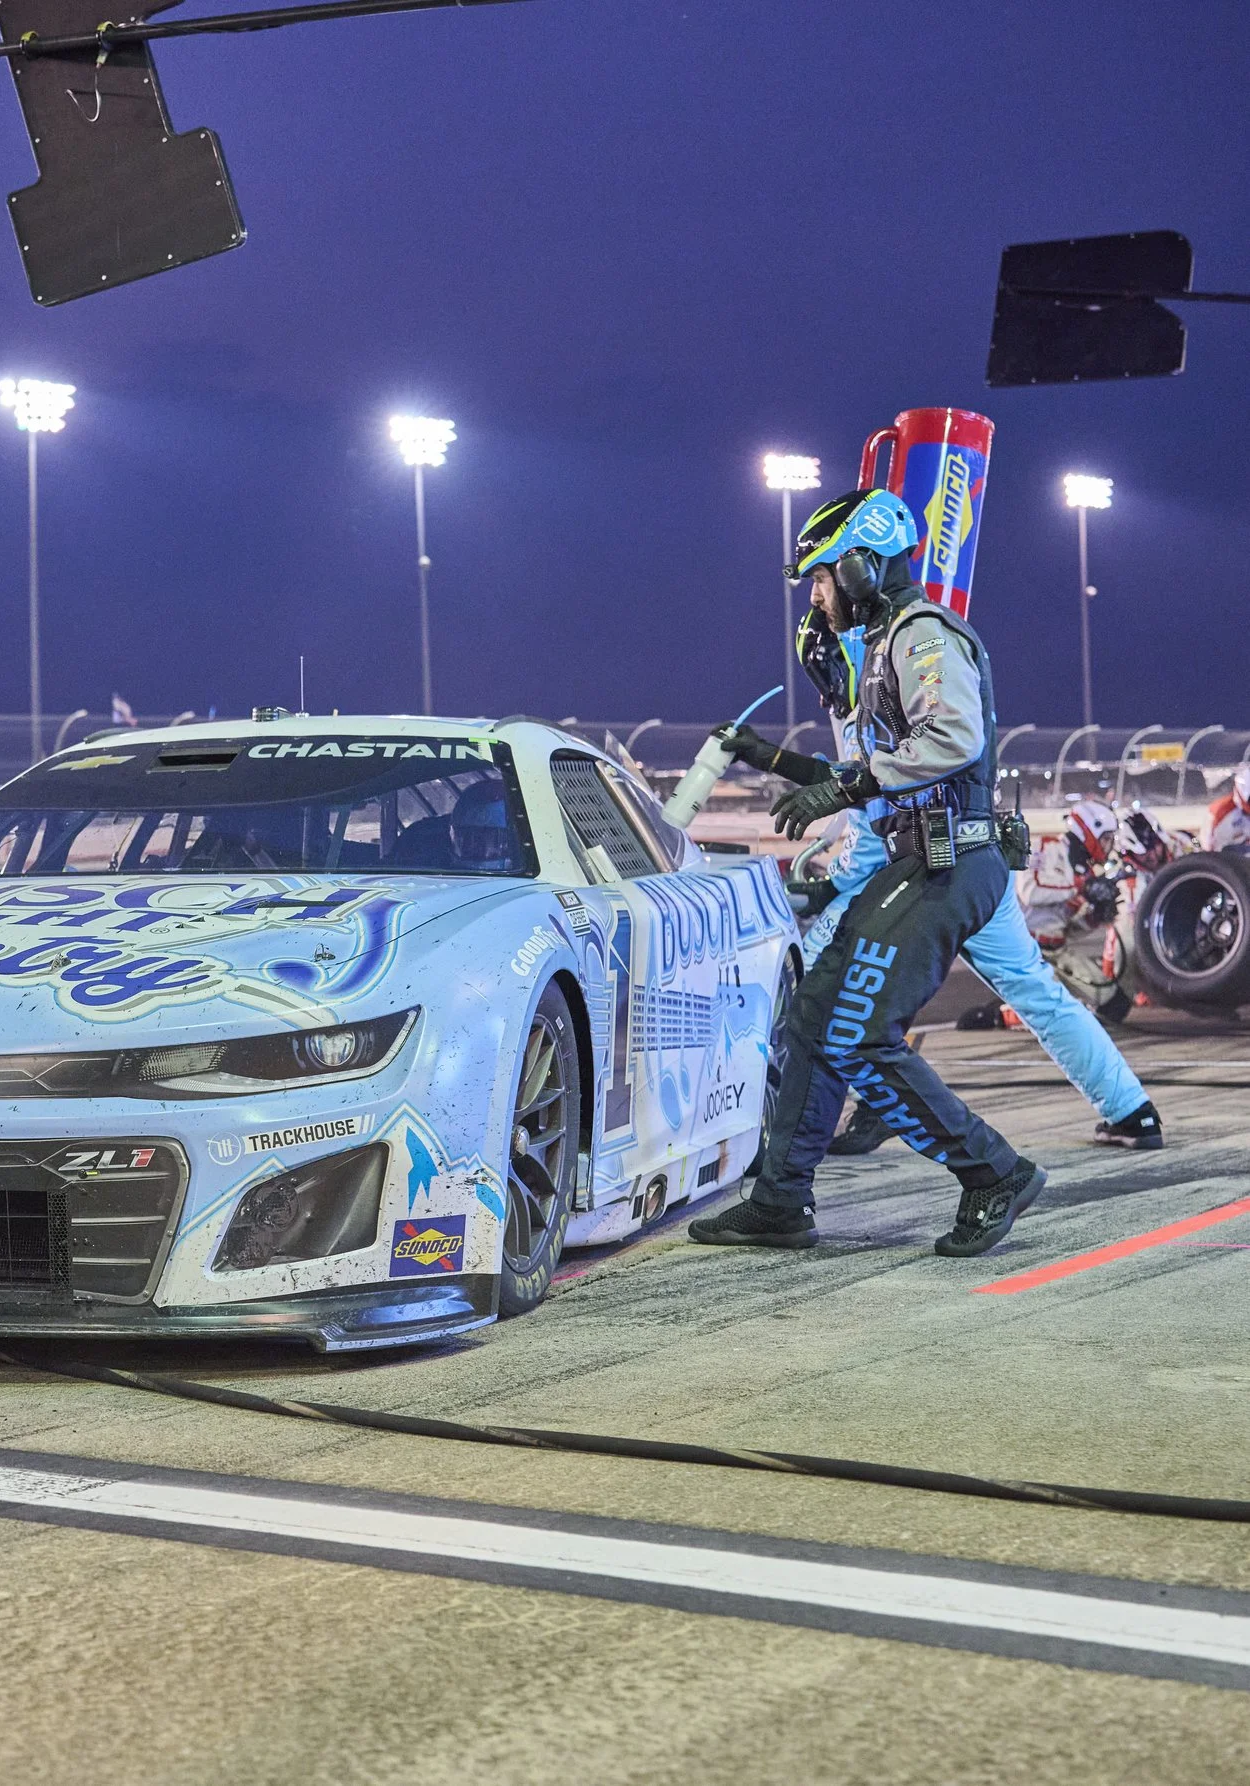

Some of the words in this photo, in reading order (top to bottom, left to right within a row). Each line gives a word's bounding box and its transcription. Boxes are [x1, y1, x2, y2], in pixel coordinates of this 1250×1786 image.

[935, 457, 969, 570] SUNOCO
[915, 638, 946, 653] NASCAR
[248, 742, 486, 761] CHASTAIN
[703, 1081, 746, 1124] JOCKEY
[249, 1119, 357, 1152] TRACKHOUSE
[57, 1148, 157, 1171] ZL1
[396, 1236, 462, 1258] SUNOCO
